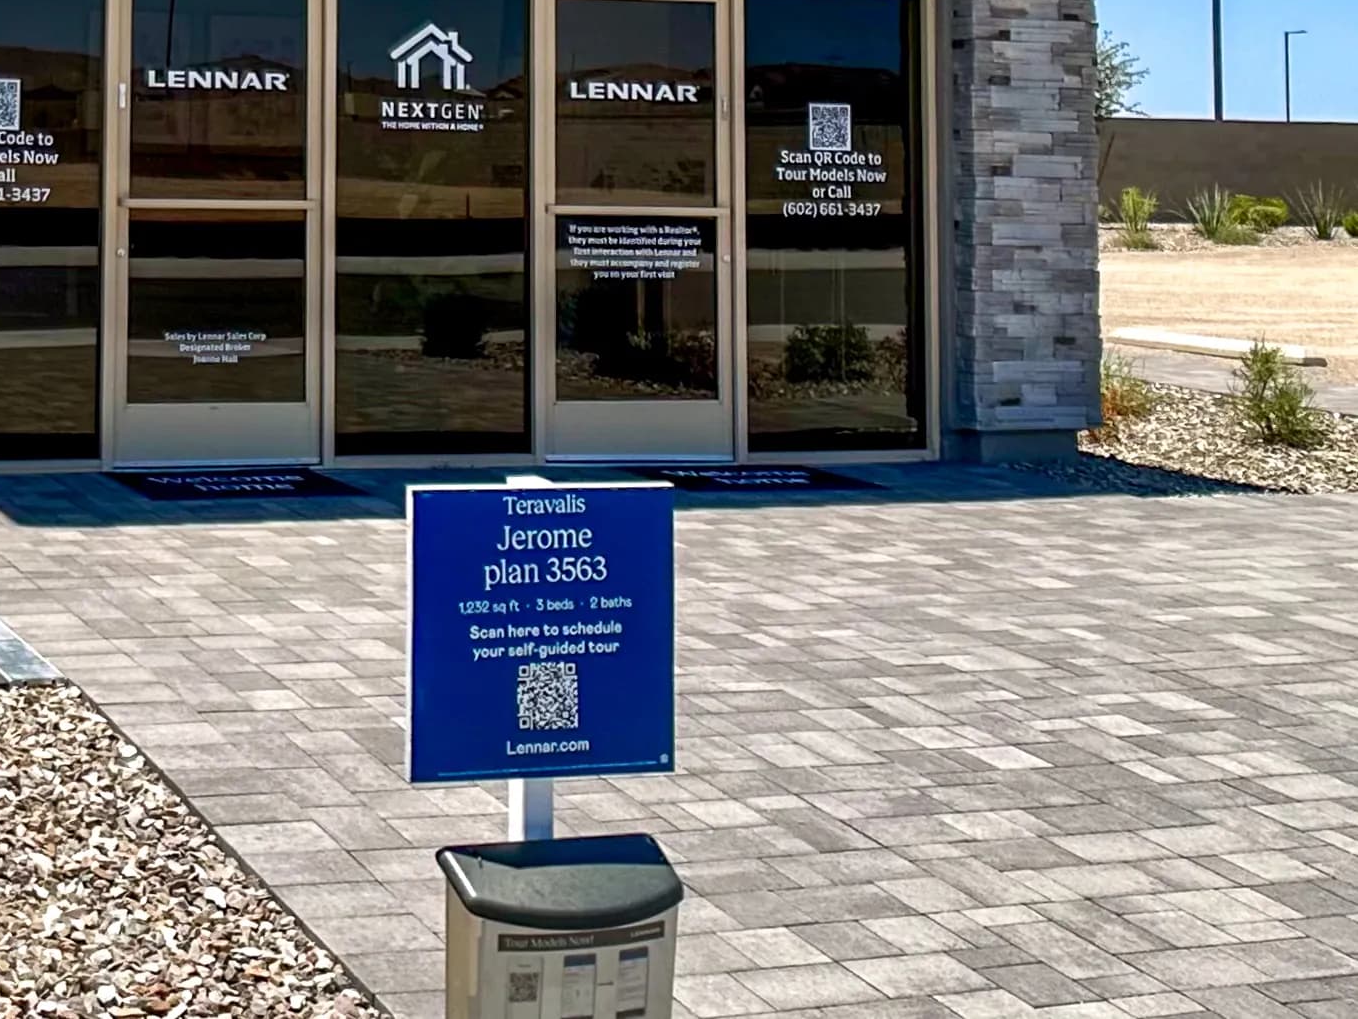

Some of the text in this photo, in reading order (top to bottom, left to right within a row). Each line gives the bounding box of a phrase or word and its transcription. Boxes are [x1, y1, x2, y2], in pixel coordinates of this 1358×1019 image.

[147, 70, 289, 91] LENNAR
[570, 82, 700, 103] LENNAR
[382, 122, 397, 130] THE
[398, 122, 420, 130] HOME
[422, 122, 449, 131] WITHIN
[450, 123, 456, 131] A
[37, 133, 54, 146] to
[23, 150, 59, 165] Now
[781, 150, 882, 166] Scan QR Code to
[776, 167, 887, 182] Tour Models Now
[812, 185, 852, 199] or Call
[783, 202, 881, 218] (602) 661-3437
[577, 226, 592, 234] you
[607, 225, 638, 235] working
[640, 225, 657, 234] with
[568, 237, 586, 245] they
[619, 237, 656, 245] identified
[658, 237, 682, 247] during
[684, 238, 702, 246] your
[573, 247, 697, 257] first interaction with Lennar and
[570, 259, 700, 269] they must accompany and register
[594, 271, 608, 280] you
[621, 272, 639, 280] your
[640, 270, 657, 279] first
[658, 271, 675, 279] visit
[164, 332, 267, 342] Sales by Lennar Sales Corp
[179, 343, 251, 353] Designated Broker
[146, 475, 305, 483] Welcome
[502, 494, 586, 515] Teravalis
[496, 525, 592, 551] Jerome
[484, 555, 607, 591] plan 3563
[458, 596, 632, 615] 1,232 sq ft 3 beds 2 baths
[469, 620, 622, 640] Scan here to schedule
[473, 641, 620, 662] your self-guided tour
[506, 740, 590, 756] Lennar.com
[504, 937, 529, 949] Tour
[530, 936, 567, 948] Models
